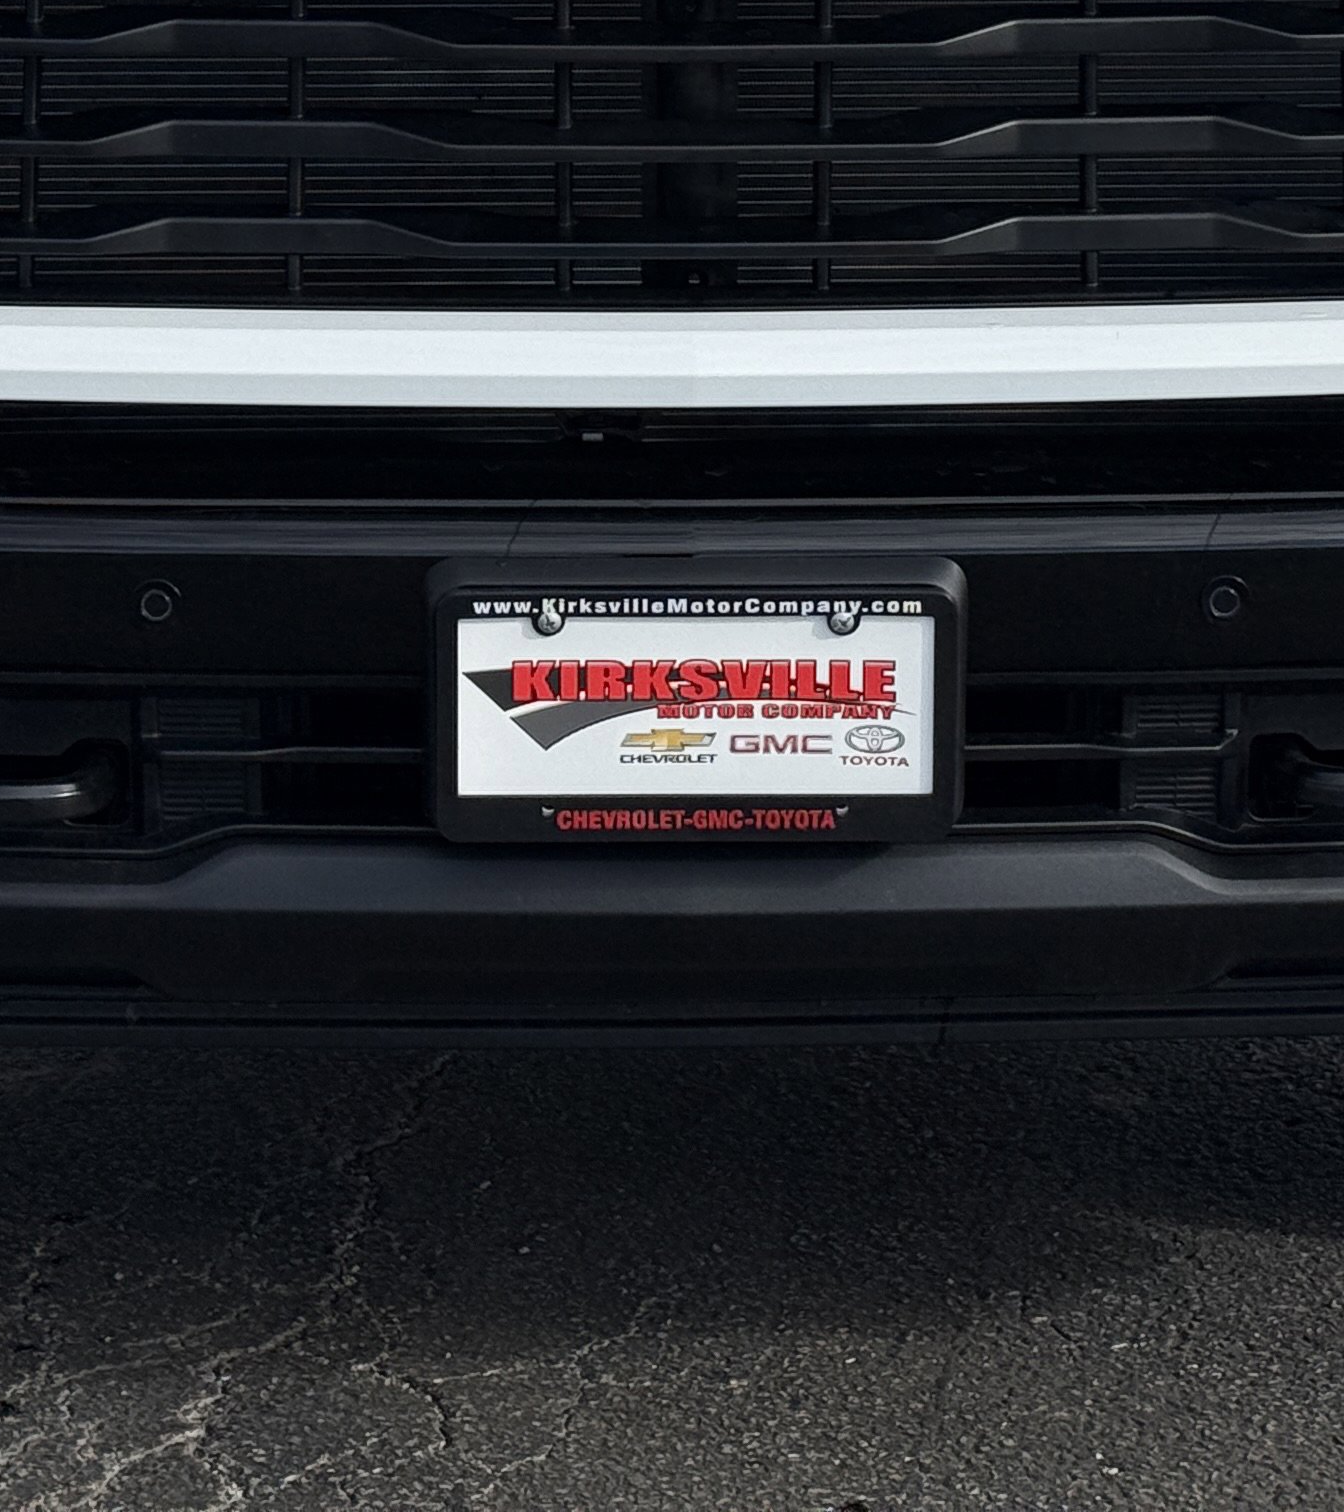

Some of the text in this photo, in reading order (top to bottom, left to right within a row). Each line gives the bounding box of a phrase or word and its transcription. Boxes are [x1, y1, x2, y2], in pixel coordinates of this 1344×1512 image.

[472, 598, 923, 615] www.KirksvilleMotorCompany.com
[511, 659, 897, 702] KIRKSVILLE
[656, 704, 895, 720] MOTOR COMPANY
[729, 734, 834, 755] GMC
[619, 753, 718, 765] CHEVROLET
[839, 755, 910, 767] TOYOTA
[556, 809, 837, 831] CHEVROLET-GMC-TOYOTA
